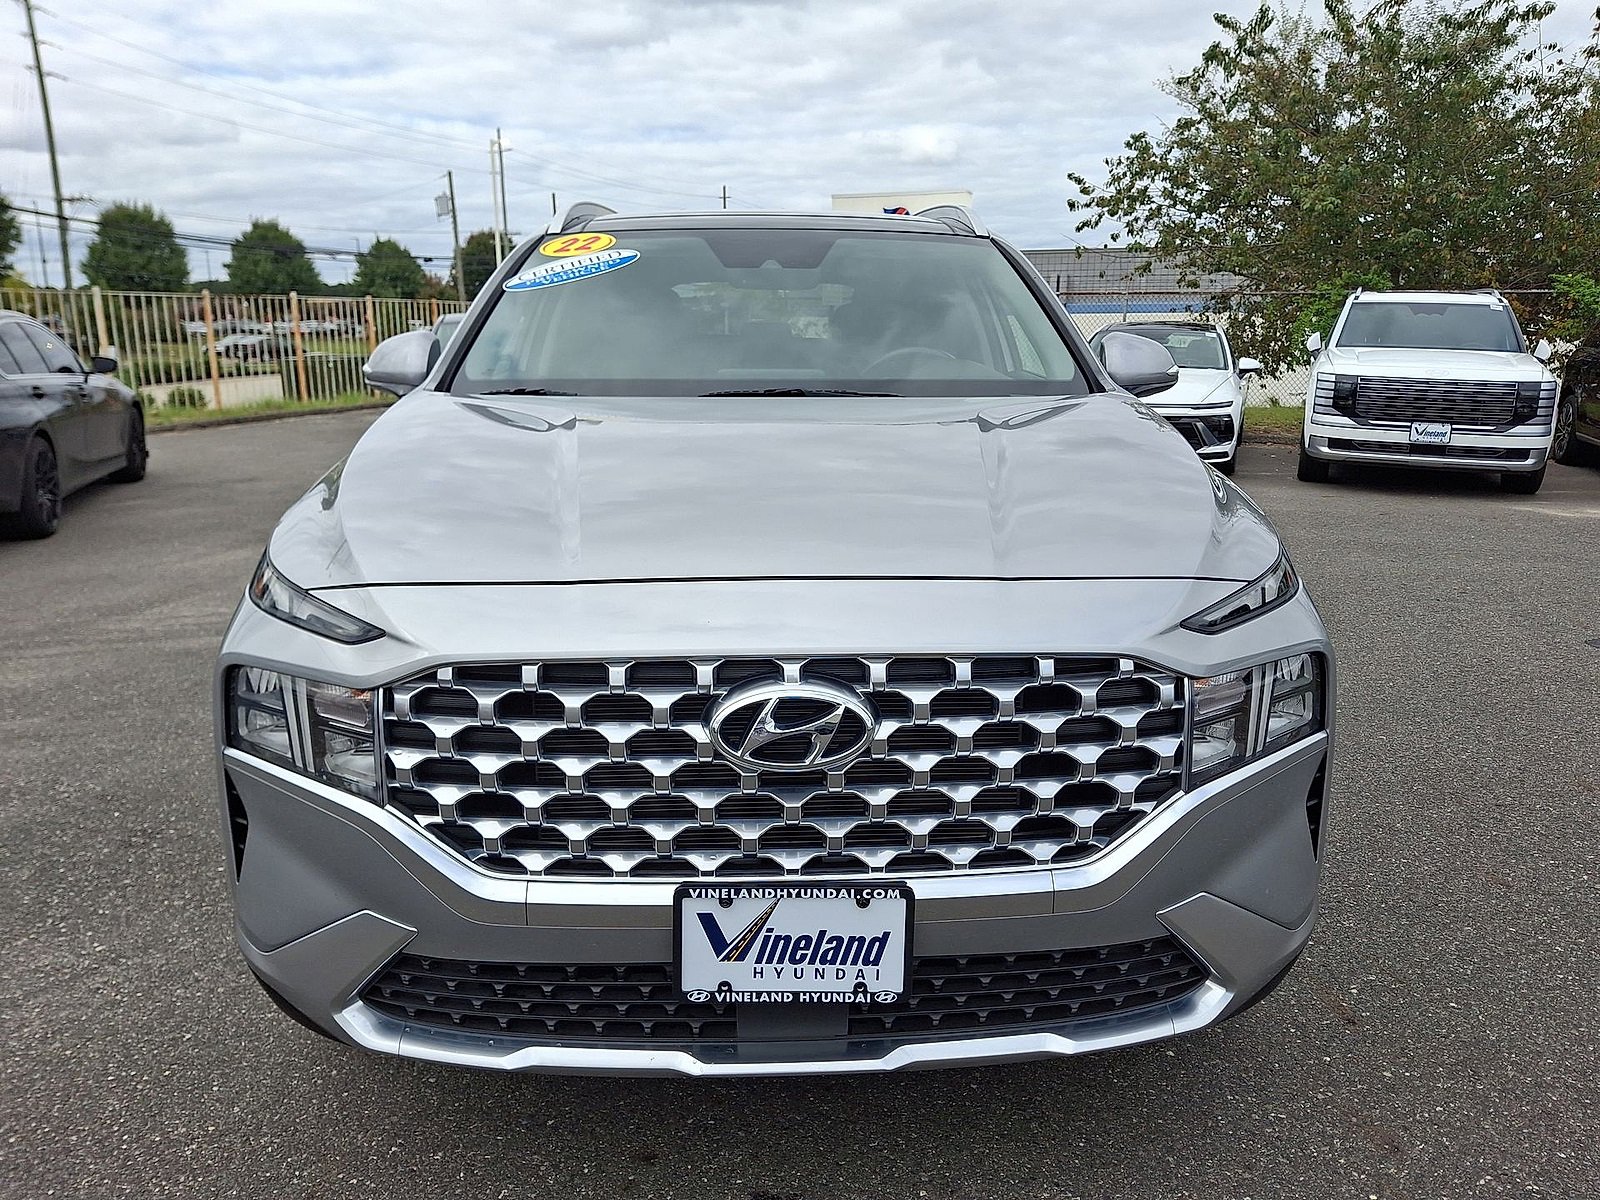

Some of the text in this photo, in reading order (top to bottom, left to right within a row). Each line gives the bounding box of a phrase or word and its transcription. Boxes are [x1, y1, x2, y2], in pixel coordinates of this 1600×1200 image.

[553, 237, 601, 253] 22
[518, 251, 622, 281] CERTIFIED
[1415, 424, 1448, 437] Vineland
[688, 888, 901, 899] VINELANDHYUNDAI.COM
[696, 898, 892, 966] Vineland
[753, 966, 881, 981] HYUNDAI
[714, 992, 871, 1003] VINELAND HYUNDAI
